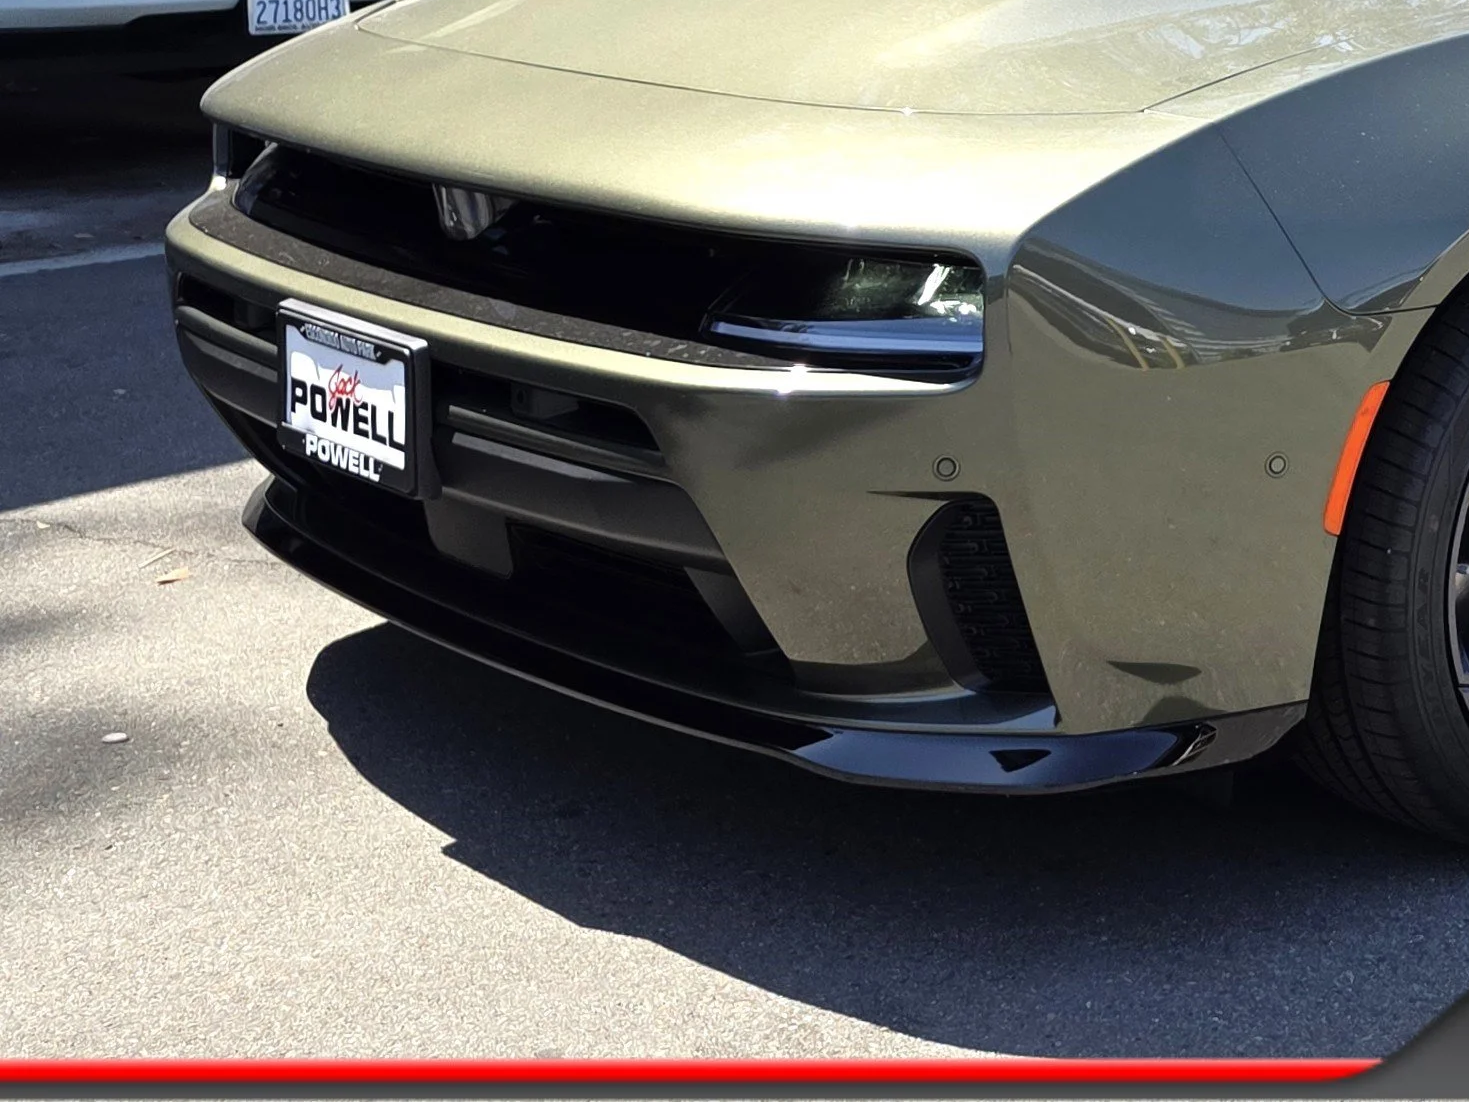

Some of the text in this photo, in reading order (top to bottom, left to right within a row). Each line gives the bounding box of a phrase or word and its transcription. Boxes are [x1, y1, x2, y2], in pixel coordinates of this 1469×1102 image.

[328, 364, 363, 411] Jack
[291, 377, 405, 453] POWELL
[305, 433, 381, 482] POWELL
